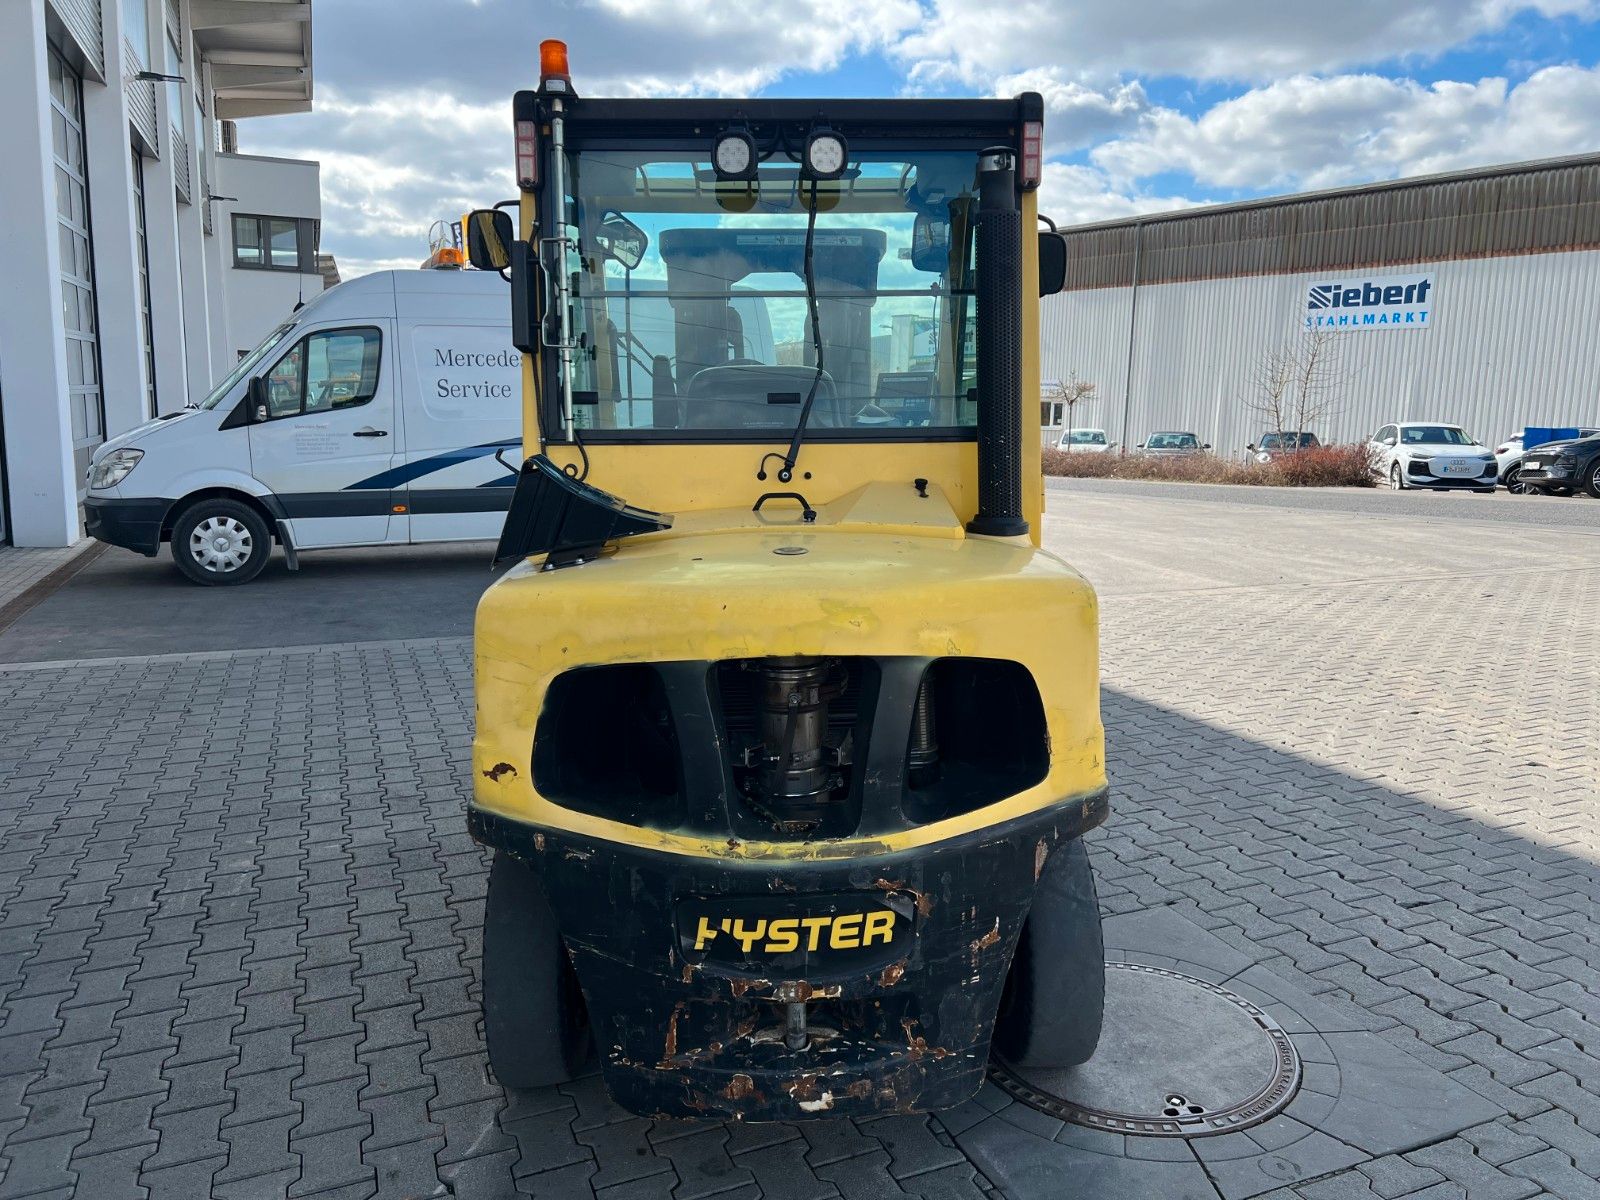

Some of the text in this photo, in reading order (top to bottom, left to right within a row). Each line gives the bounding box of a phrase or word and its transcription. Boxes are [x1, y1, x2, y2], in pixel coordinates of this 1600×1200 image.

[1308, 279, 1431, 309] Siebert
[1306, 311, 1428, 326] STAHLMARKT
[435, 348, 523, 367] Mercede
[437, 378, 511, 398] Service
